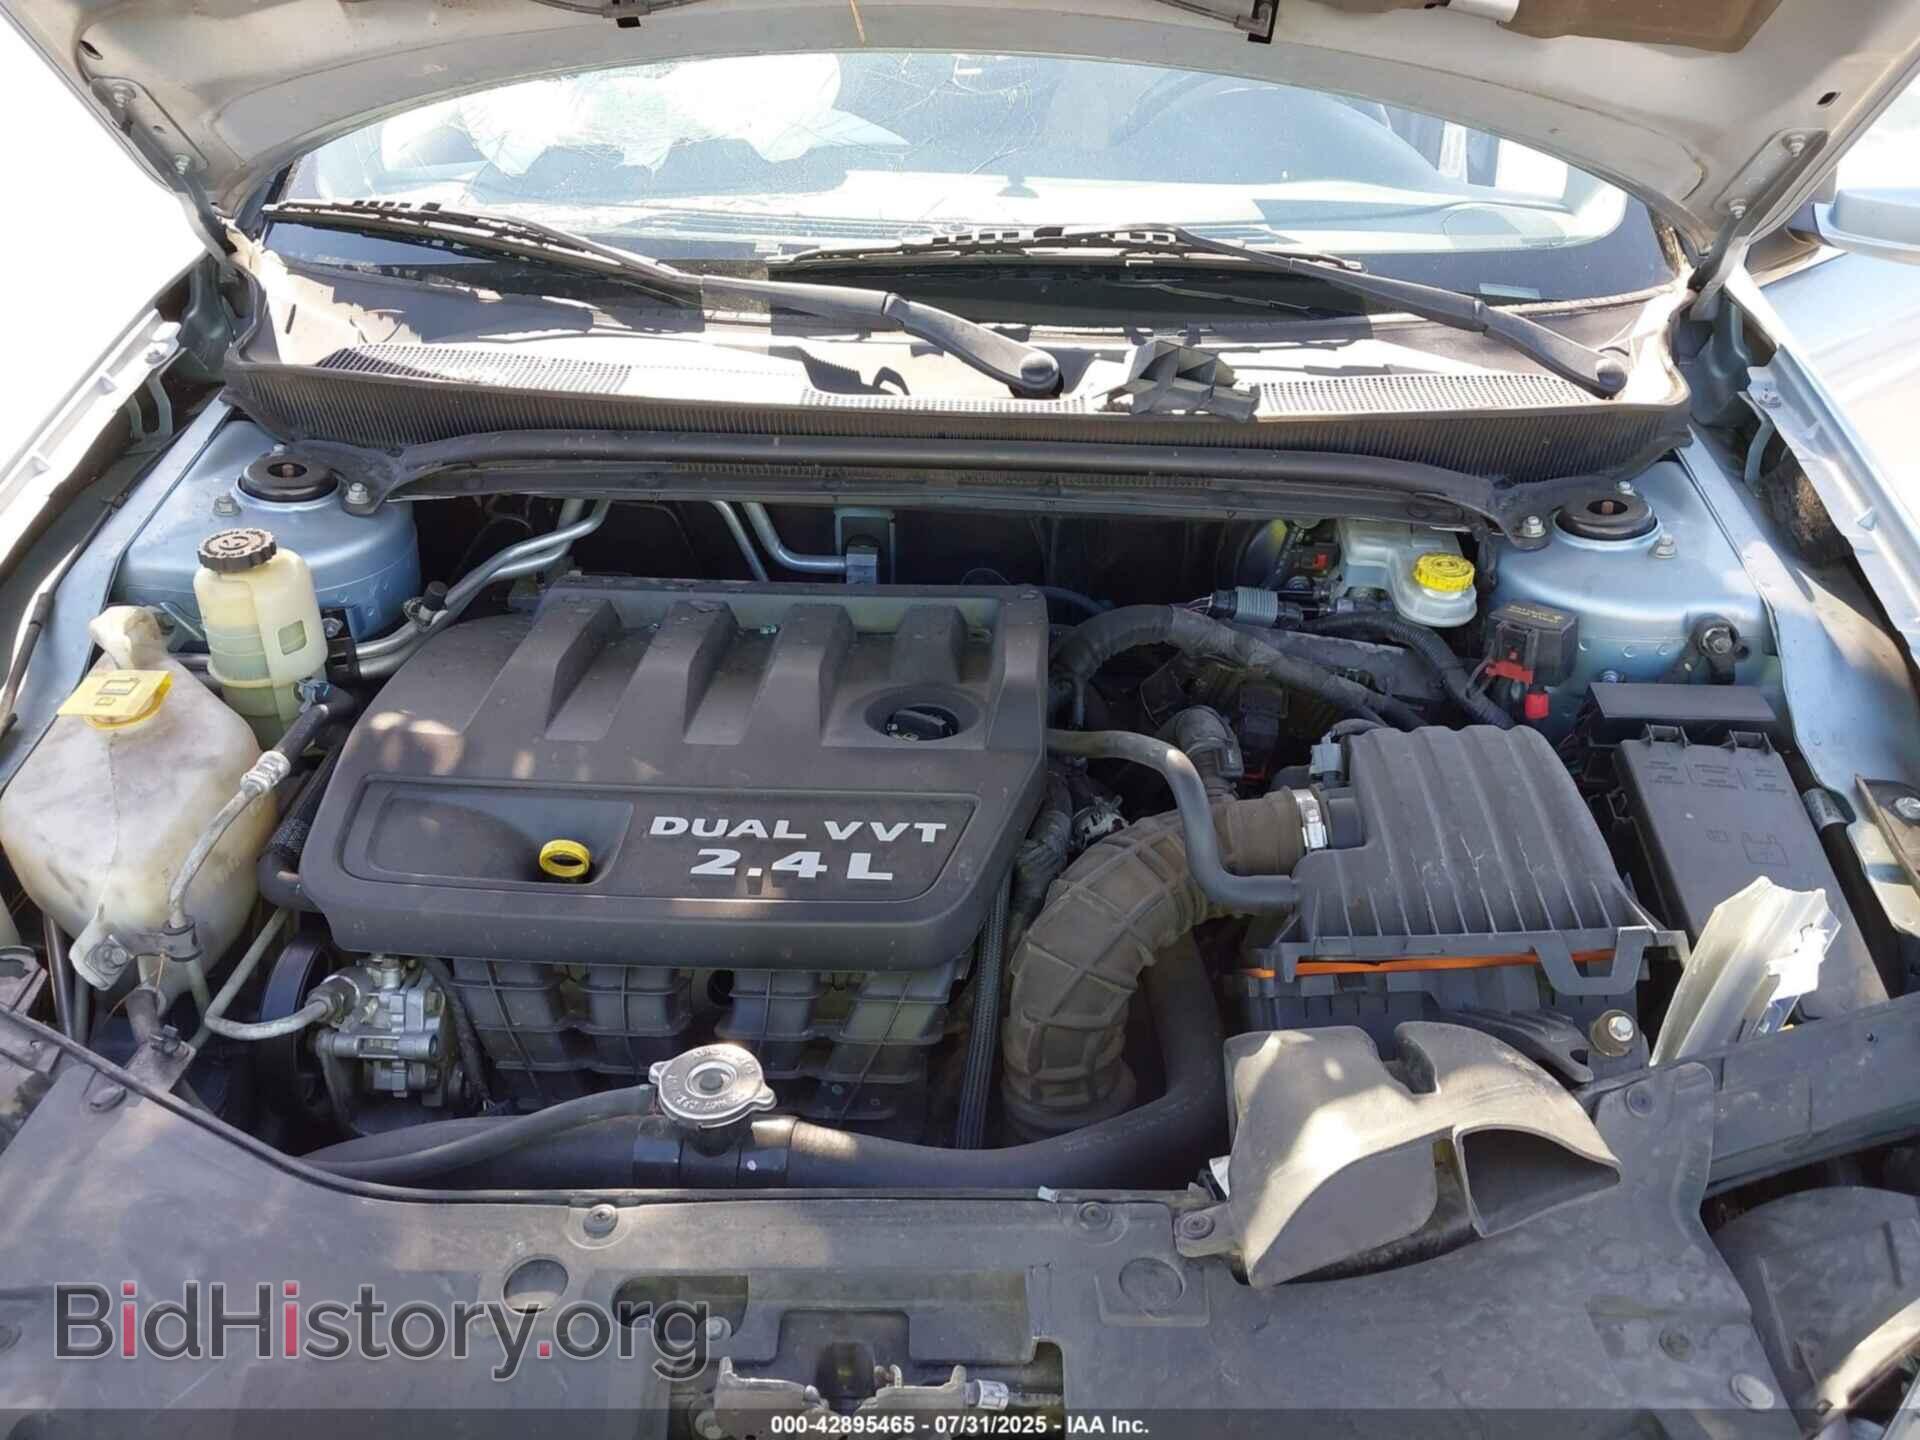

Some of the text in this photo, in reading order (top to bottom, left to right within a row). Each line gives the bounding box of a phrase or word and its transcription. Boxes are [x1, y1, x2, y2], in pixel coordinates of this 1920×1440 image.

[649, 816, 947, 843] DUAL VVT
[689, 848, 894, 881] 2.4 L
